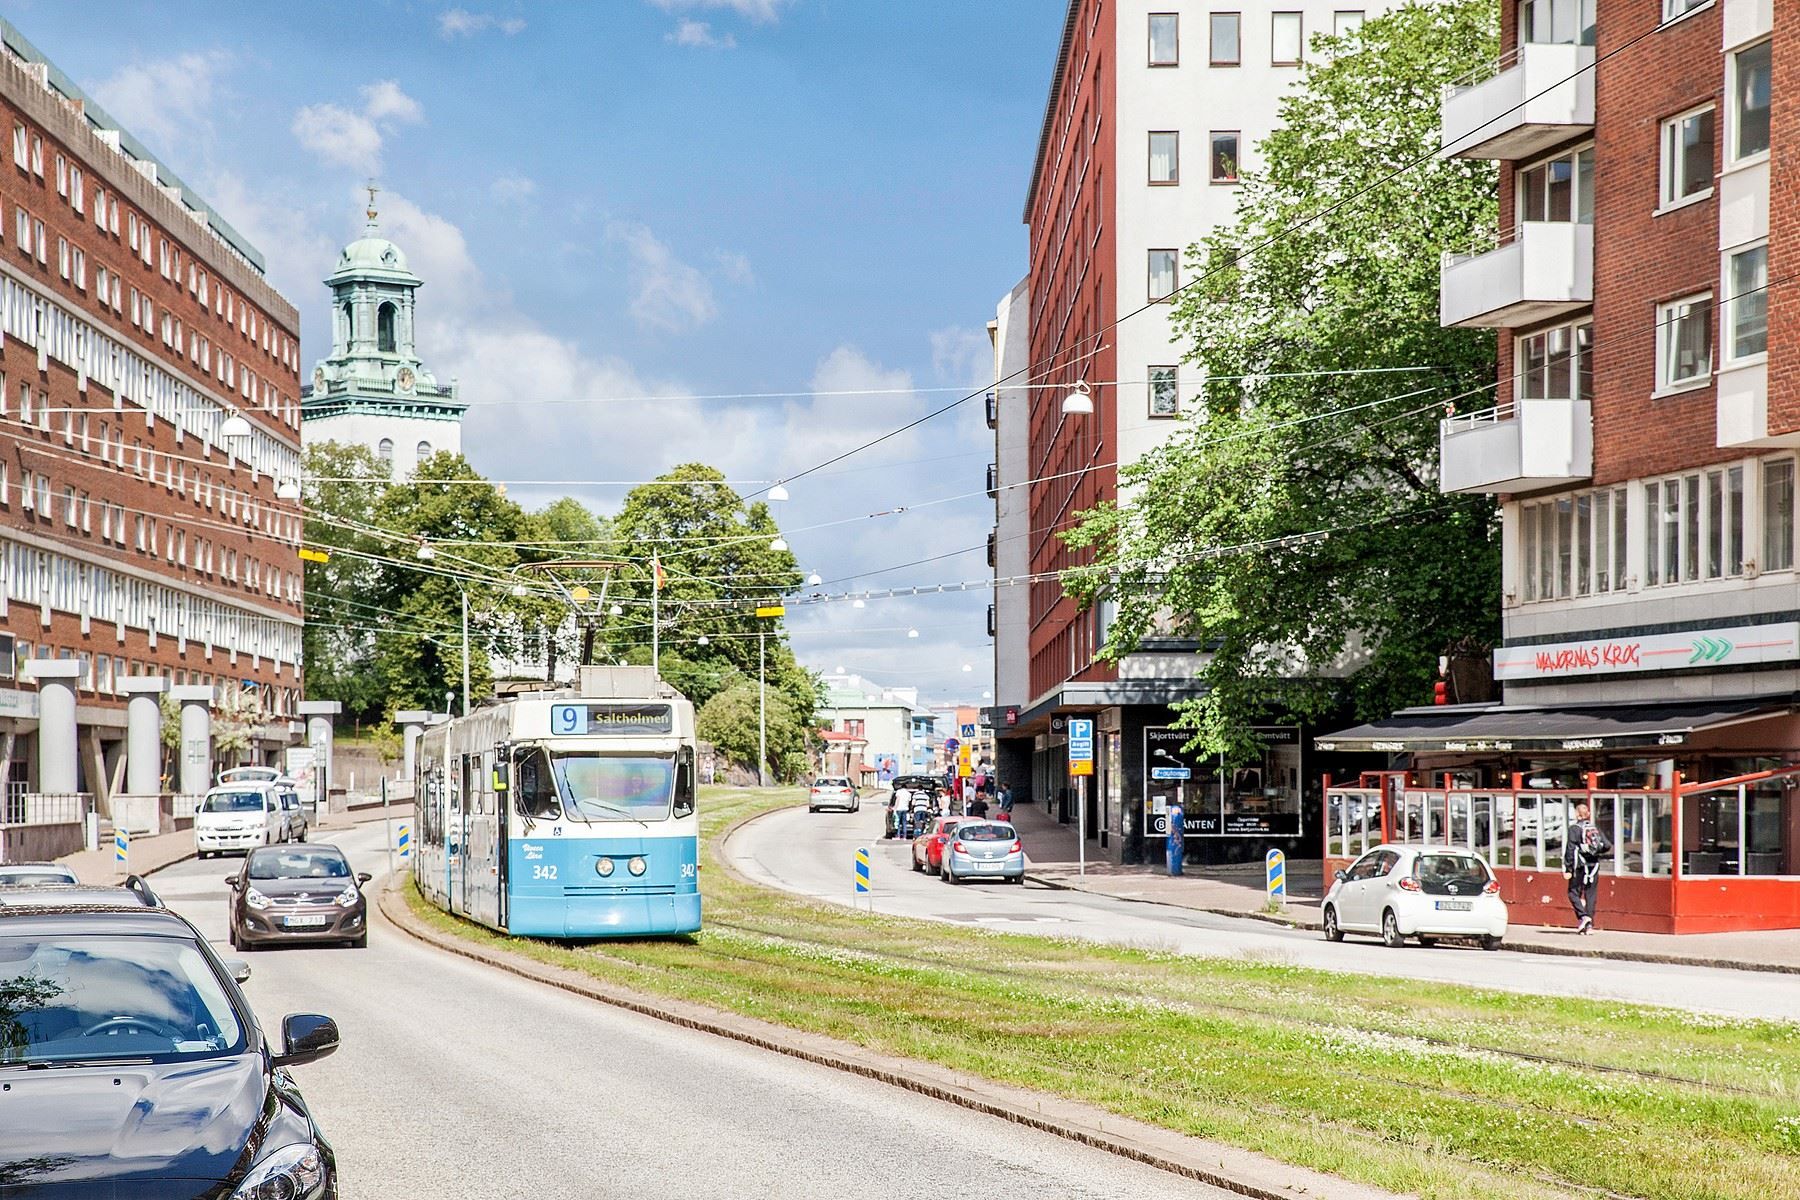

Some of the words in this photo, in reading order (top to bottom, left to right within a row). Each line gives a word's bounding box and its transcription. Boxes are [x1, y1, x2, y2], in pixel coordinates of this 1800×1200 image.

[1535, 646, 1599, 673] MAJORNAS
[1603, 643, 1640, 668] KROG
[562, 707, 577, 731] 9
[596, 713, 669, 724] Saltholmen
[1075, 722, 1087, 738] P
[1149, 732, 1190, 741] Skjorttvätt
[532, 864, 558, 880] 342
[681, 863, 695, 878] 342
